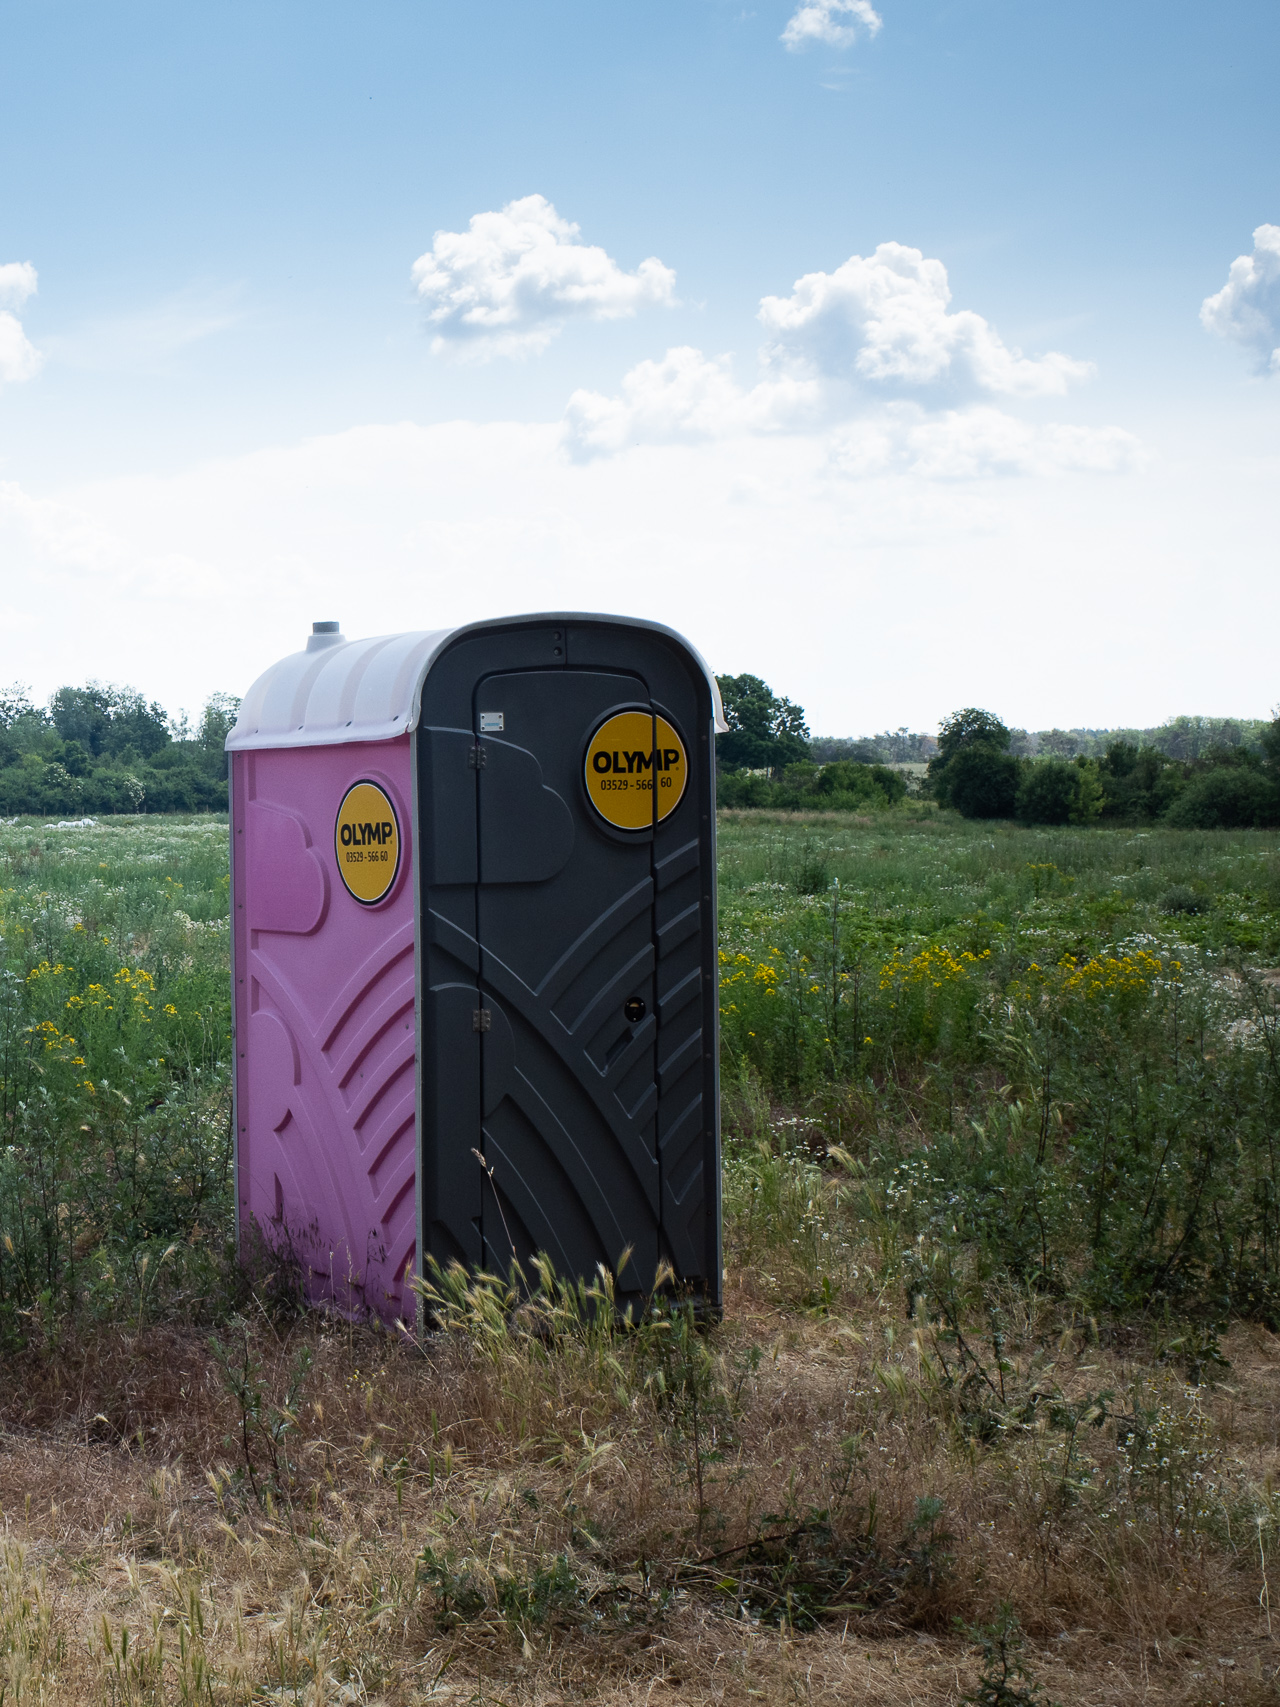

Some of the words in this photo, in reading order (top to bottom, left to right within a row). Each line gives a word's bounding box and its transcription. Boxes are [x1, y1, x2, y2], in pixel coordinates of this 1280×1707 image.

[593, 749, 680, 774] OLYMP
[660, 776, 672, 788] 60
[340, 822, 392, 846] OLYMP
[380, 850, 388, 862] 60
